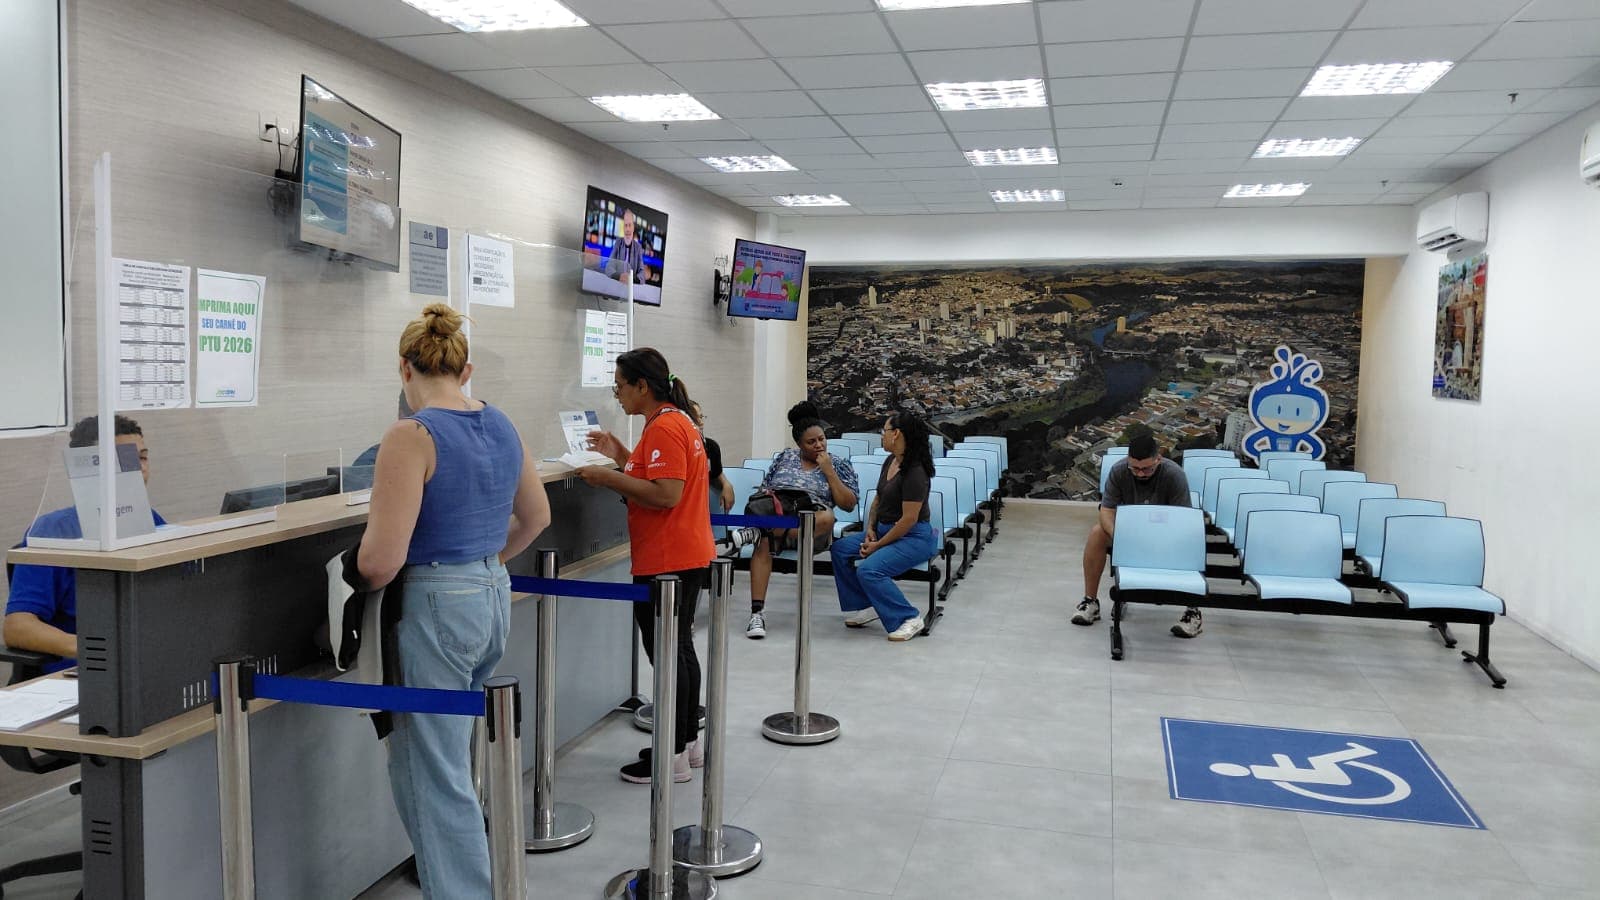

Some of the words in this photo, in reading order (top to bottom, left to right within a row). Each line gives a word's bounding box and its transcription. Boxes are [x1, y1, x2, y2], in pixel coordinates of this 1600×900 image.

[199, 299, 231, 314] MPRIMA
[233, 303, 255, 316] AQUI
[202, 318, 214, 329] SEU
[215, 318, 235, 330] CARNÊ
[236, 320, 247, 331] DO
[223, 336, 253, 353] 2026
